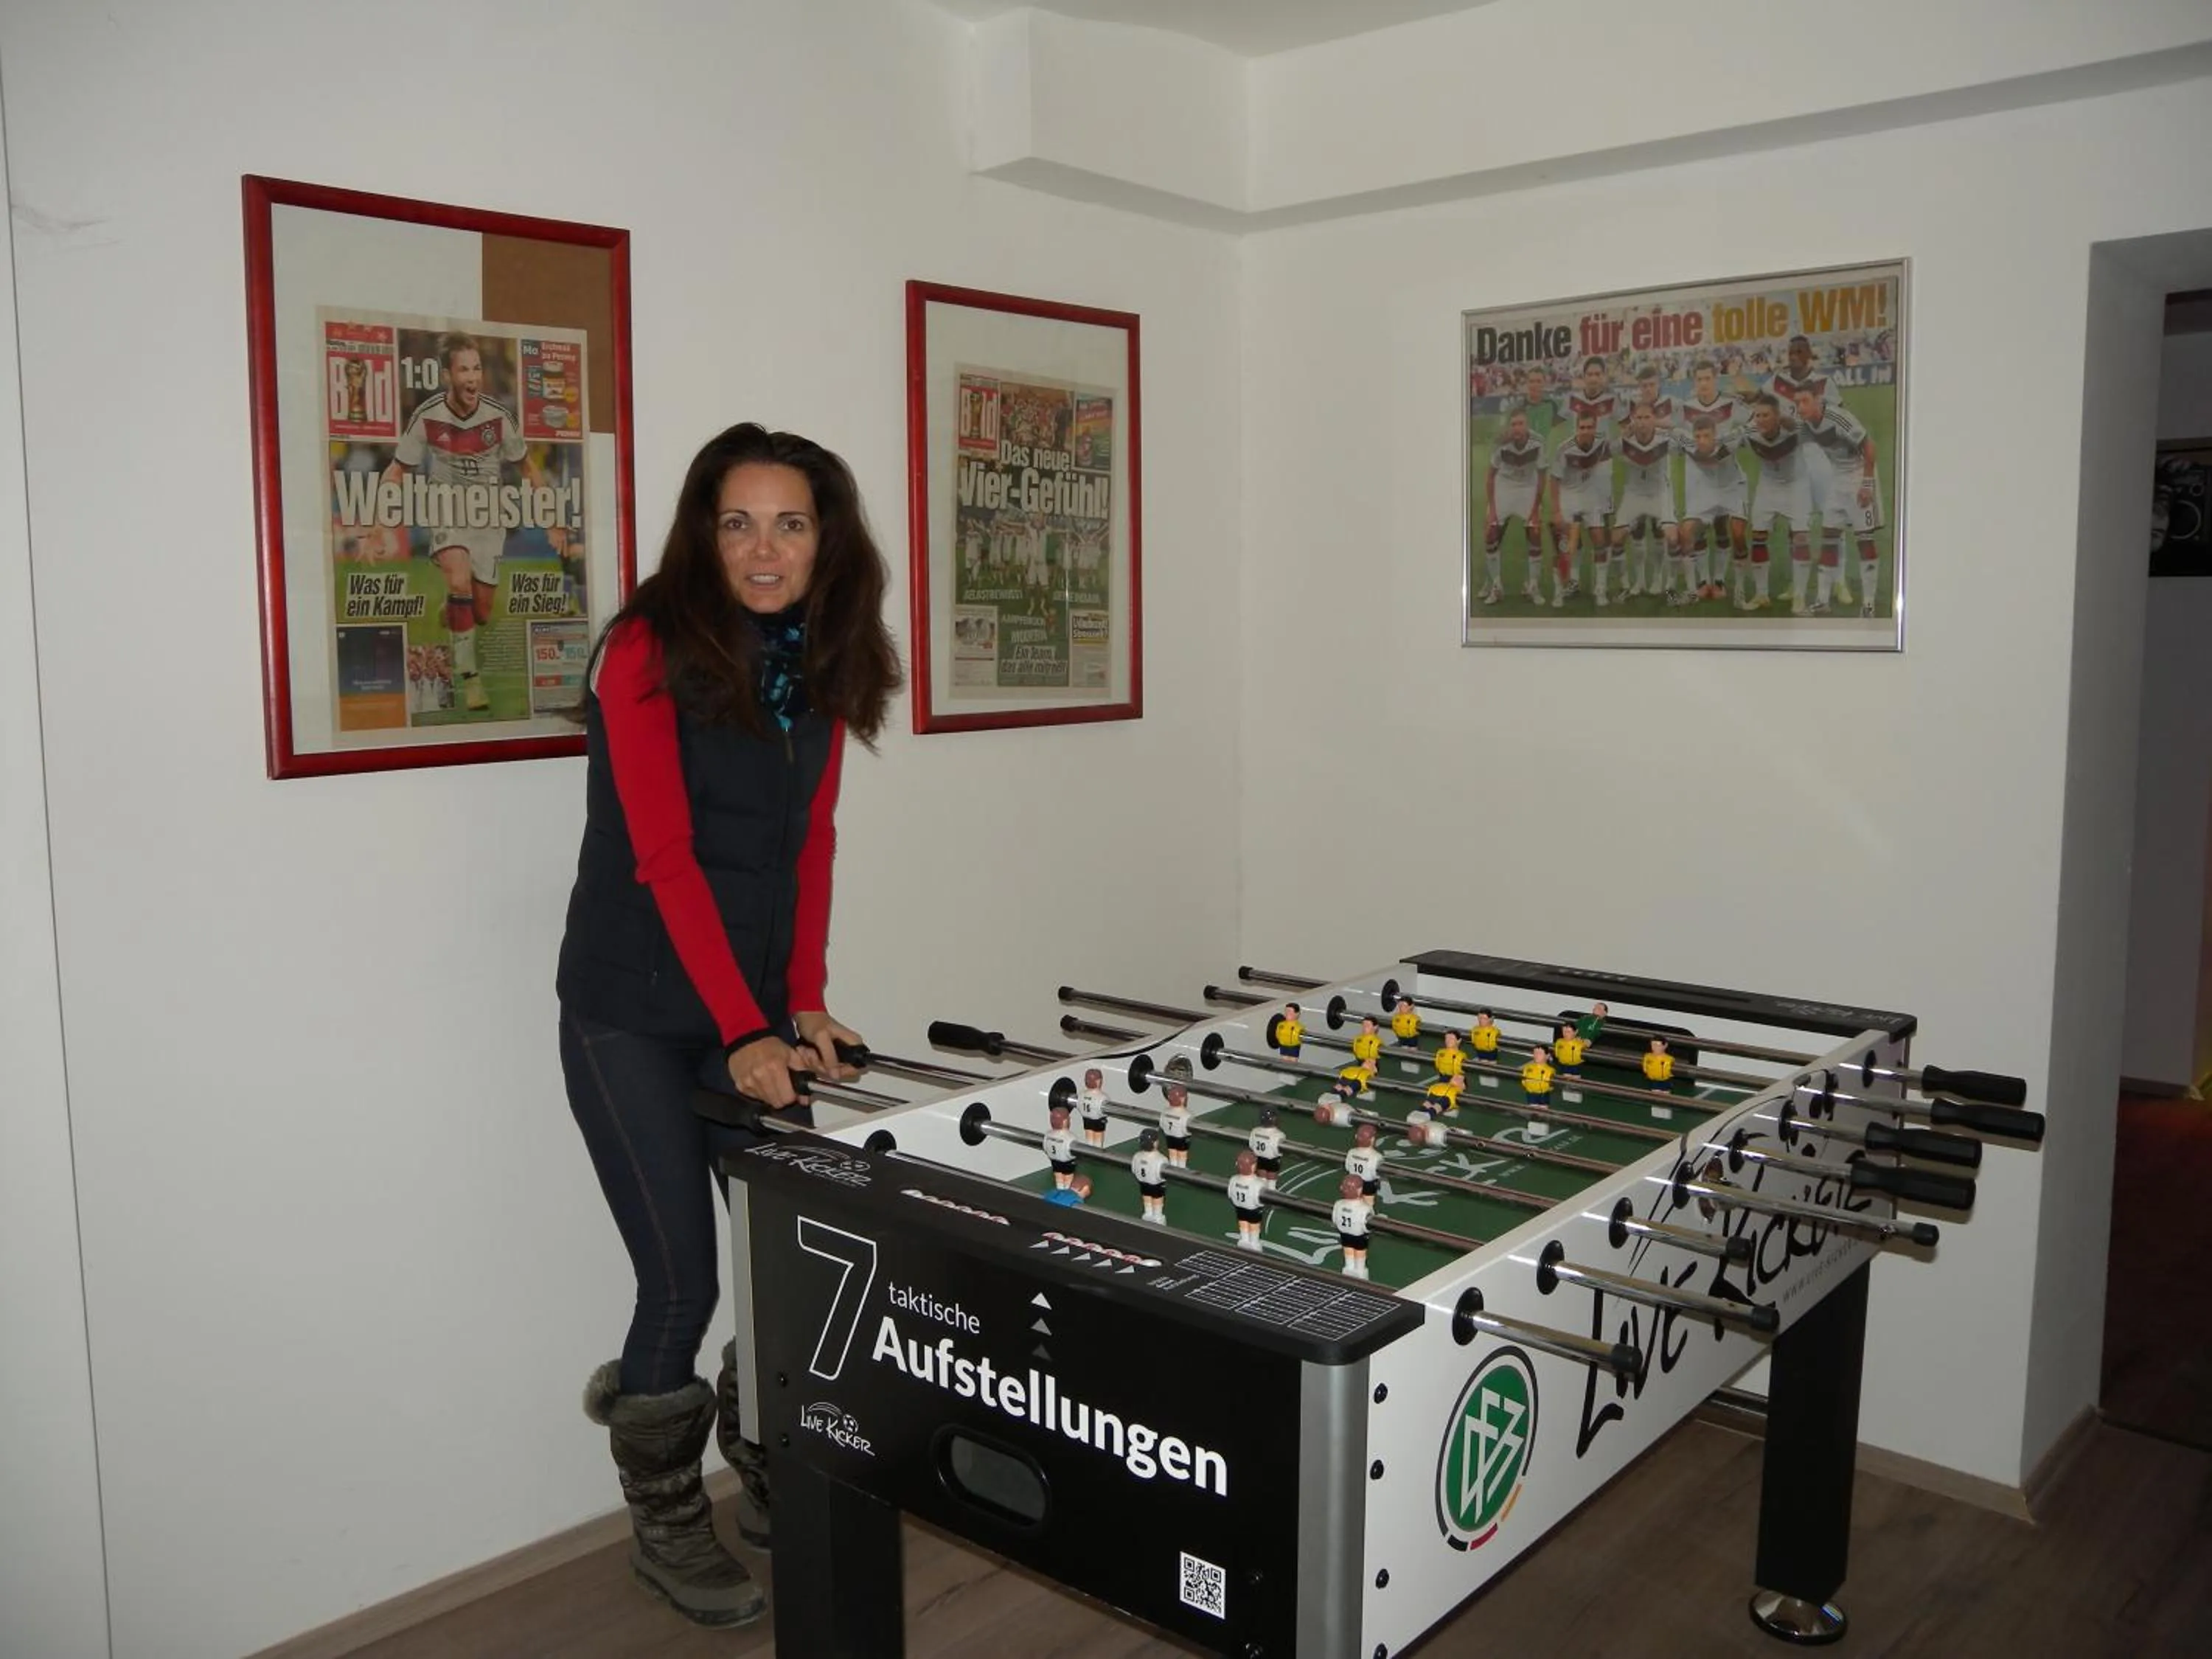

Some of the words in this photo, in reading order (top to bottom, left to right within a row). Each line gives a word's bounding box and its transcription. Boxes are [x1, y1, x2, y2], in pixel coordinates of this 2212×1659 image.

[1476, 321, 1572, 366] Danke
[1579, 313, 1624, 357] für
[1631, 303, 1704, 352] eine
[1712, 297, 1788, 344] tolle
[1796, 282, 1888, 334] WM!
[328, 356, 393, 422] Bld
[401, 356, 439, 391] 1:0
[960, 387, 998, 440] Bld
[1001, 439, 1030, 467] Das
[1034, 447, 1070, 472] neue
[334, 470, 582, 529] Weltmeister!
[959, 461, 1109, 520] Vier-Gefühl!
[349, 574, 380, 595] Was
[382, 574, 405, 594] für
[510, 574, 542, 593] Was
[542, 574, 560, 593] für
[347, 597, 369, 617] ein
[372, 595, 425, 619] Kampf!
[509, 595, 532, 613] ein
[532, 593, 567, 615] Sieg!
[1353, 1163, 1363, 1174] 10
[1236, 1192, 1246, 1203] 13
[1341, 1216, 1352, 1228] 21
[798, 1214, 877, 1380] 7
[888, 1281, 980, 1334] taktische
[872, 1315, 1228, 1498] Aufstellungen
